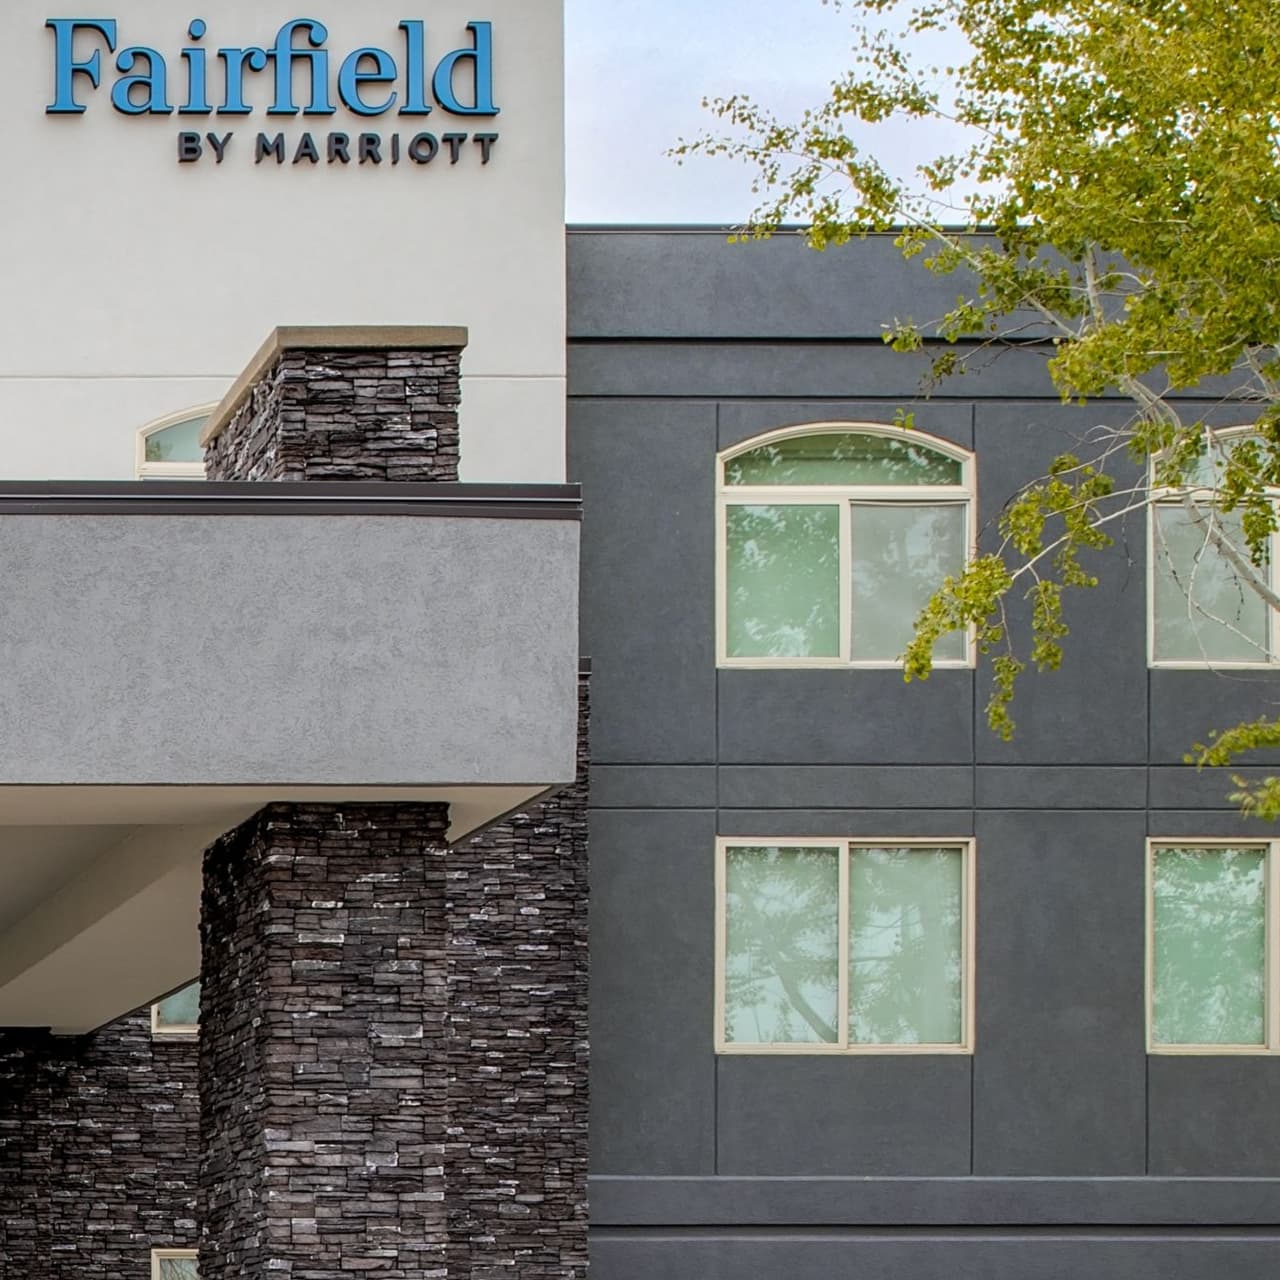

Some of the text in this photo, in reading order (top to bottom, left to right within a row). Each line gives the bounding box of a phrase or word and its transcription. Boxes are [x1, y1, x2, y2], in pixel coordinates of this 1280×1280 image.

[45, 18, 500, 117] Fairfield
[178, 131, 499, 165] BY MARRIOTT
